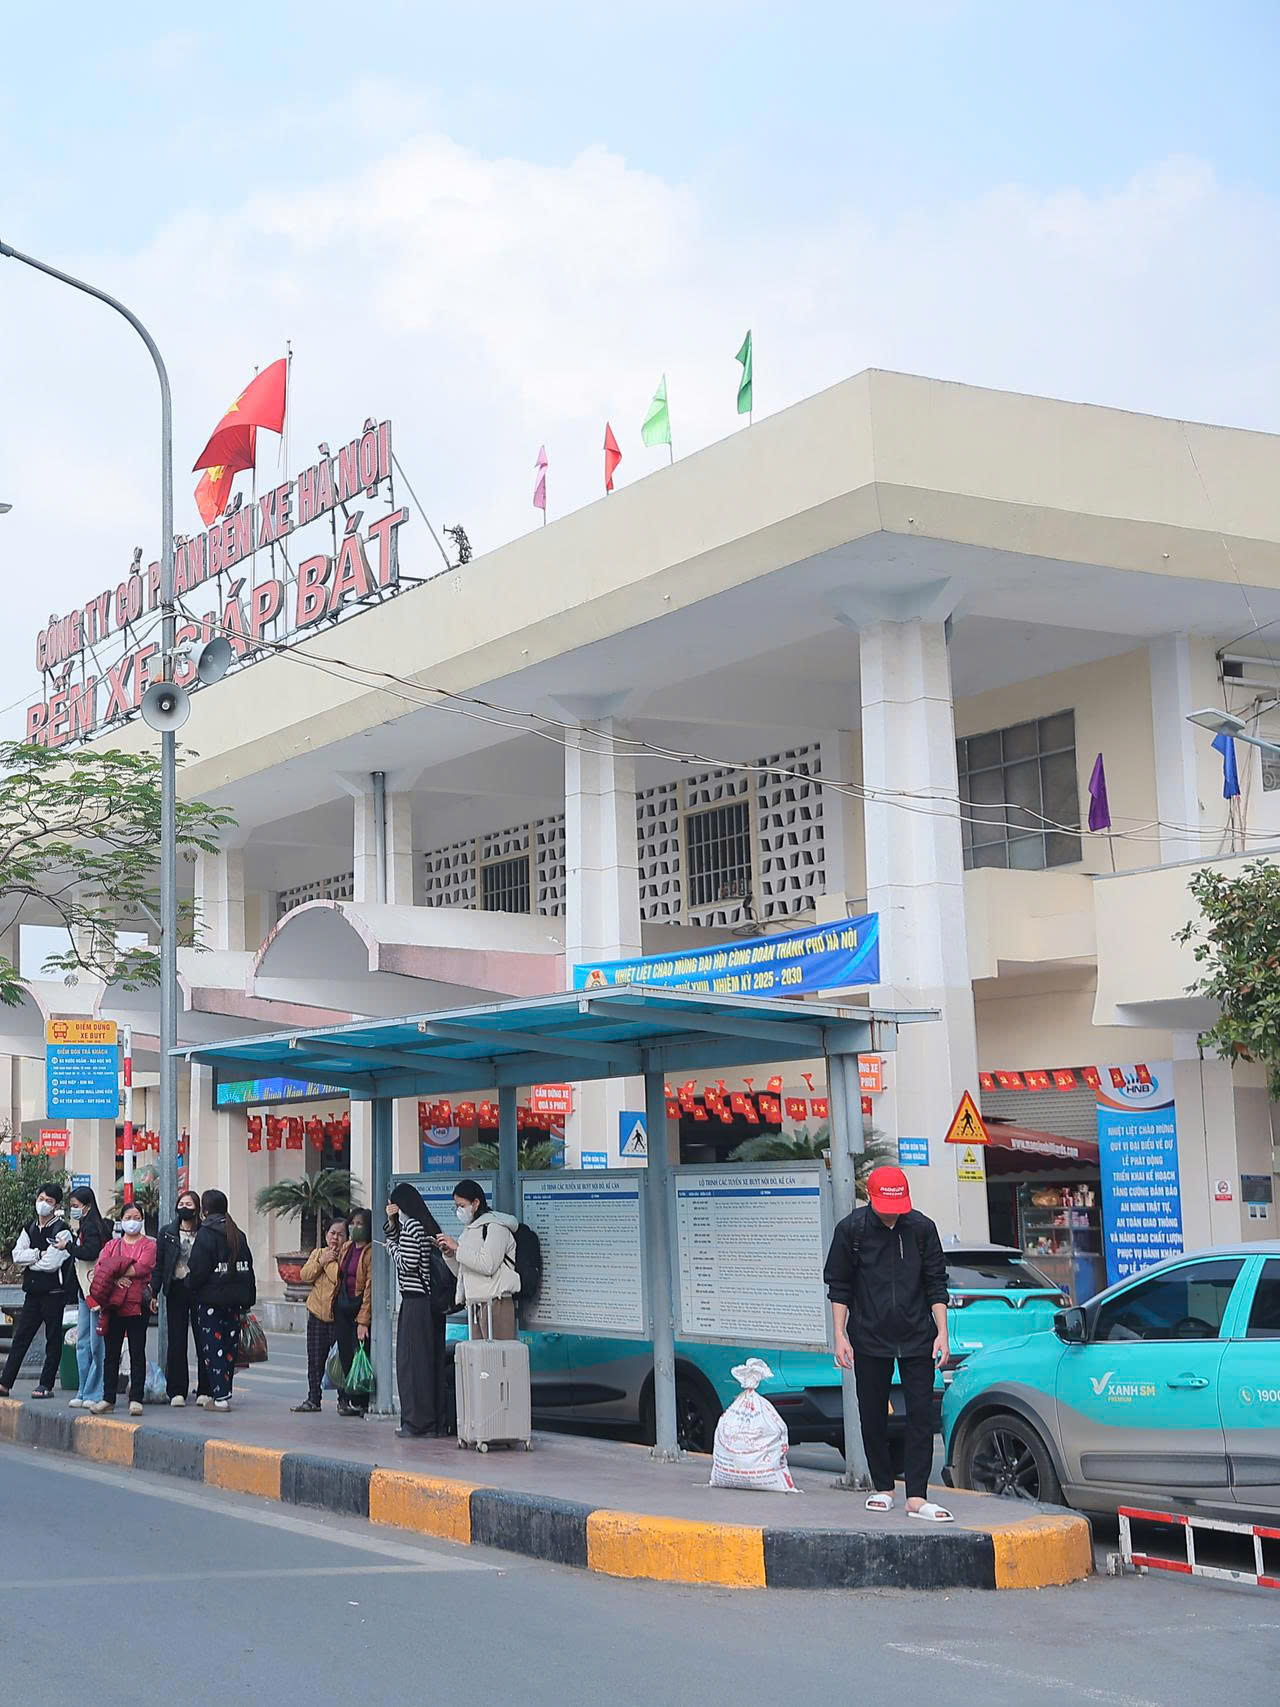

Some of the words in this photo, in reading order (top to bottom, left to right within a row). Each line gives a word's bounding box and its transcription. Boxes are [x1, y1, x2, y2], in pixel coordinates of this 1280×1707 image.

[36, 613, 85, 673] CÔNG
[85, 590, 112, 646] TY
[116, 546, 144, 628] CỔ
[148, 534, 207, 609] PẦN
[208, 491, 255, 577] BẾN
[258, 480, 294, 548] XE
[298, 442, 336, 526] HÀ
[338, 417, 392, 500] NỘI
[26, 660, 98, 748] BẾN
[104, 641, 159, 723] XE
[296, 506, 410, 628] BÁT
[636, 963, 653, 984] LIỆT
[653, 959, 674, 979] CHÀO
[674, 956, 697, 976] MỪNG
[699, 954, 712, 975] ĐẠI
[713, 950, 728, 973] HỘI
[728, 948, 752, 968] CÔNG
[751, 943, 776, 964] ĐOÀN
[776, 938, 805, 960] THÀNH
[805, 930, 825, 955] PHỐ
[826, 930, 840, 952] HÀ
[841, 927, 858, 952] NỘI
[741, 970, 752, 992] KỲ
[753, 971, 774, 990] 2025
[781, 966, 803, 985] 2030
[562, 1089, 569, 1098] XE
[1126, 1084, 1150, 1094] HNB
[1139, 1123, 1155, 1134] CHÀO
[1130, 1155, 1145, 1166] PHÁT
[1131, 1171, 1145, 1181] KHAI
[1145, 1168, 1154, 1181] KẾ
[1154, 1171, 1176, 1182] HOẠCH
[1120, 1202, 1129, 1212] AN
[1116, 1217, 1125, 1228] AN
[1126, 1216, 1142, 1228] TOÀN
[1143, 1217, 1157, 1228] GIAO
[1158, 1216, 1178, 1228] THÔNG
[1137, 1233, 1148, 1243] CAO
[1150, 1230, 1165, 1243] CHẤT
[1166, 1232, 1183, 1245] LƯỢN
[1107, 1384, 1138, 1397] XANH
[1139, 1384, 1156, 1397] SM
